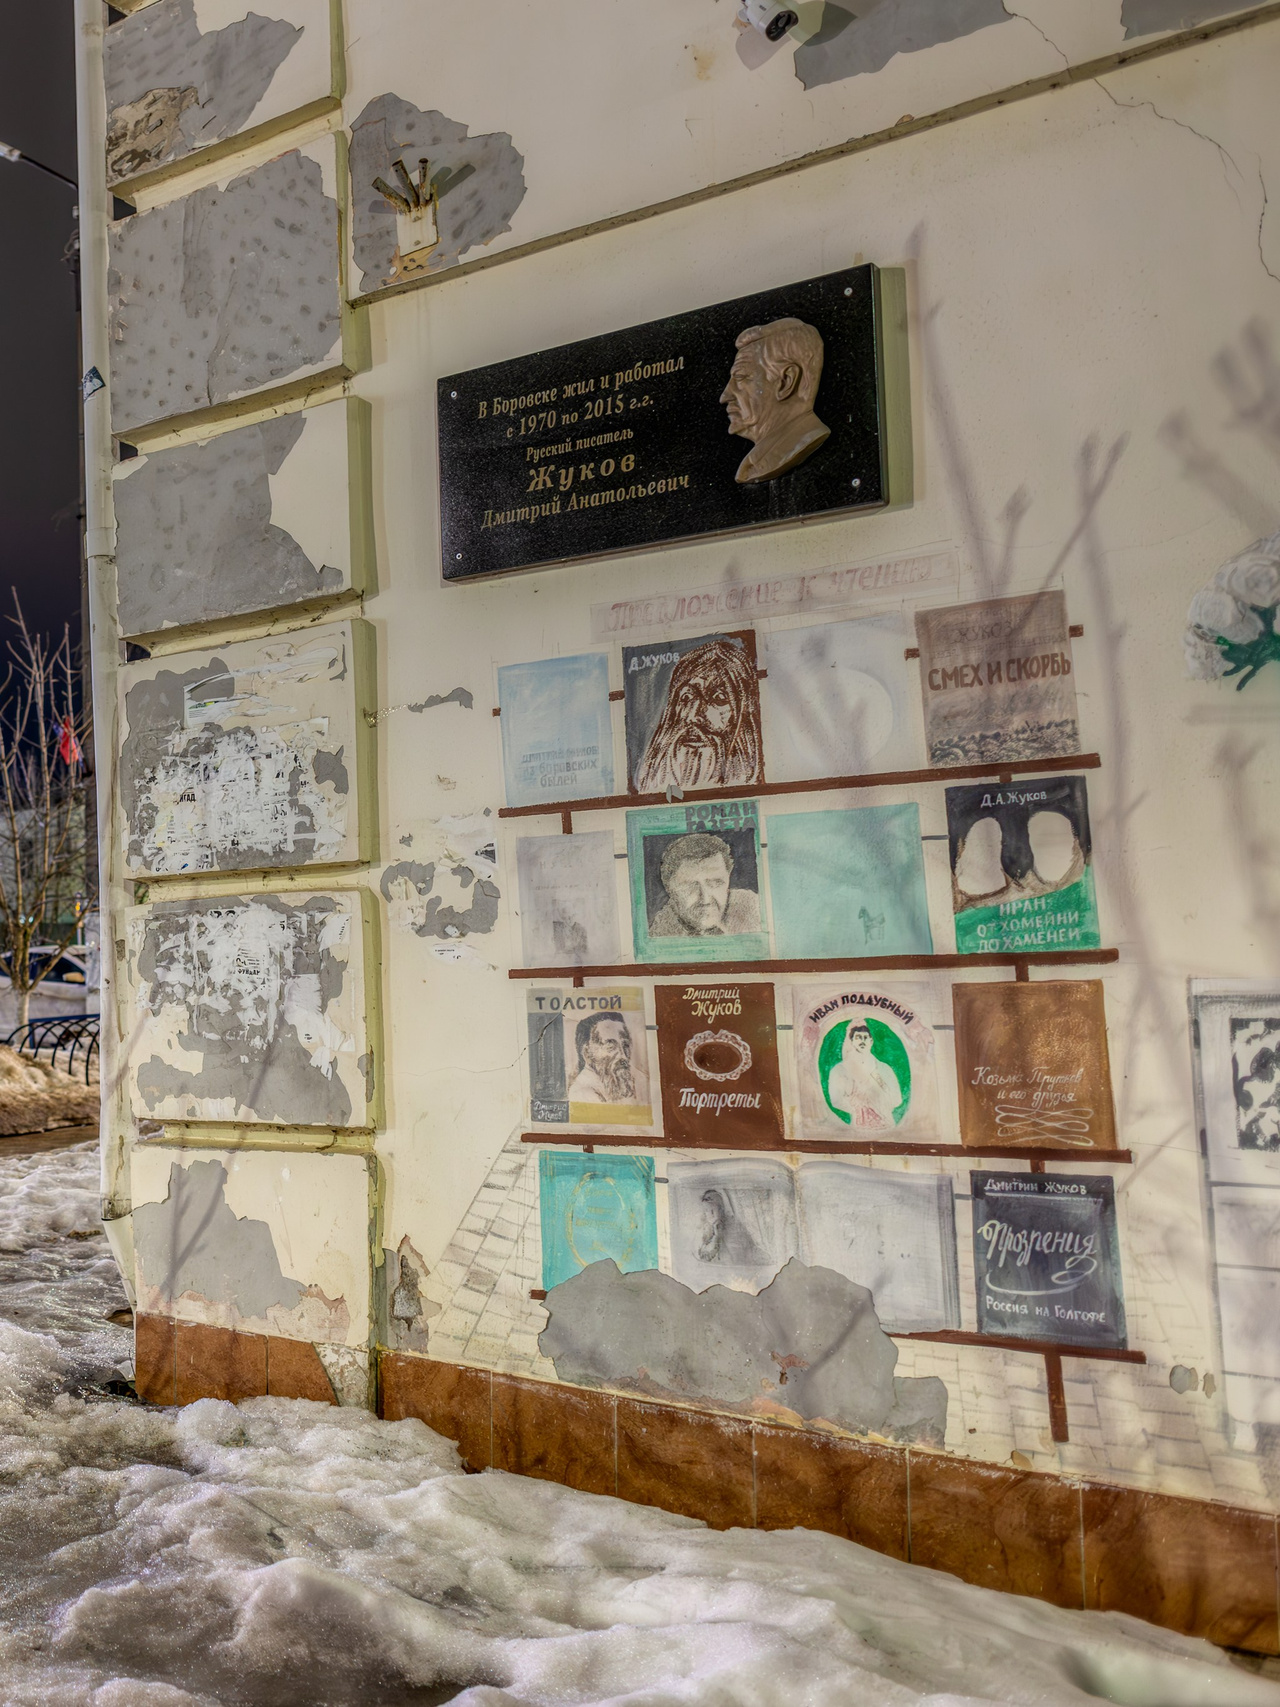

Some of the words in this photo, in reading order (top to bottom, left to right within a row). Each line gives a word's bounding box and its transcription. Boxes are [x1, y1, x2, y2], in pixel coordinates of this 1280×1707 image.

[478, 401, 487, 419] В
[492, 388, 558, 416] Боровске
[562, 378, 595, 399] жил
[600, 373, 609, 389] и
[614, 356, 685, 391] работал
[507, 427, 513, 438] с
[519, 410, 557, 436] 1970
[562, 410, 579, 426] по
[584, 394, 624, 420] 2015
[526, 437, 572, 463] Русский
[576, 428, 634, 451] писатель
[526, 454, 636, 492] Жуков
[481, 495, 562, 531] Дмитрий
[566, 475, 690, 511] Анатольевич
[928, 660, 984, 691] СМЕХ
[987, 660, 1003, 685] И
[1006, 652, 1072, 683] СКОРБЬ
[685, 801, 757, 821] РОМАН
[686, 817, 757, 833] ГАЗЕТА
[977, 920, 996, 938] ОТ
[977, 938, 1000, 954] ДО
[535, 994, 623, 1011] ТОЛСТОЙ
[682, 986, 740, 1003] Дмитрий
[691, 999, 742, 1024] Жуков
[809, 999, 839, 1023] ИВАН
[841, 994, 915, 1025] ПОДДУБНЫЙ
[678, 1087, 762, 1116] Портреты
[997, 1090, 1006, 1100] и
